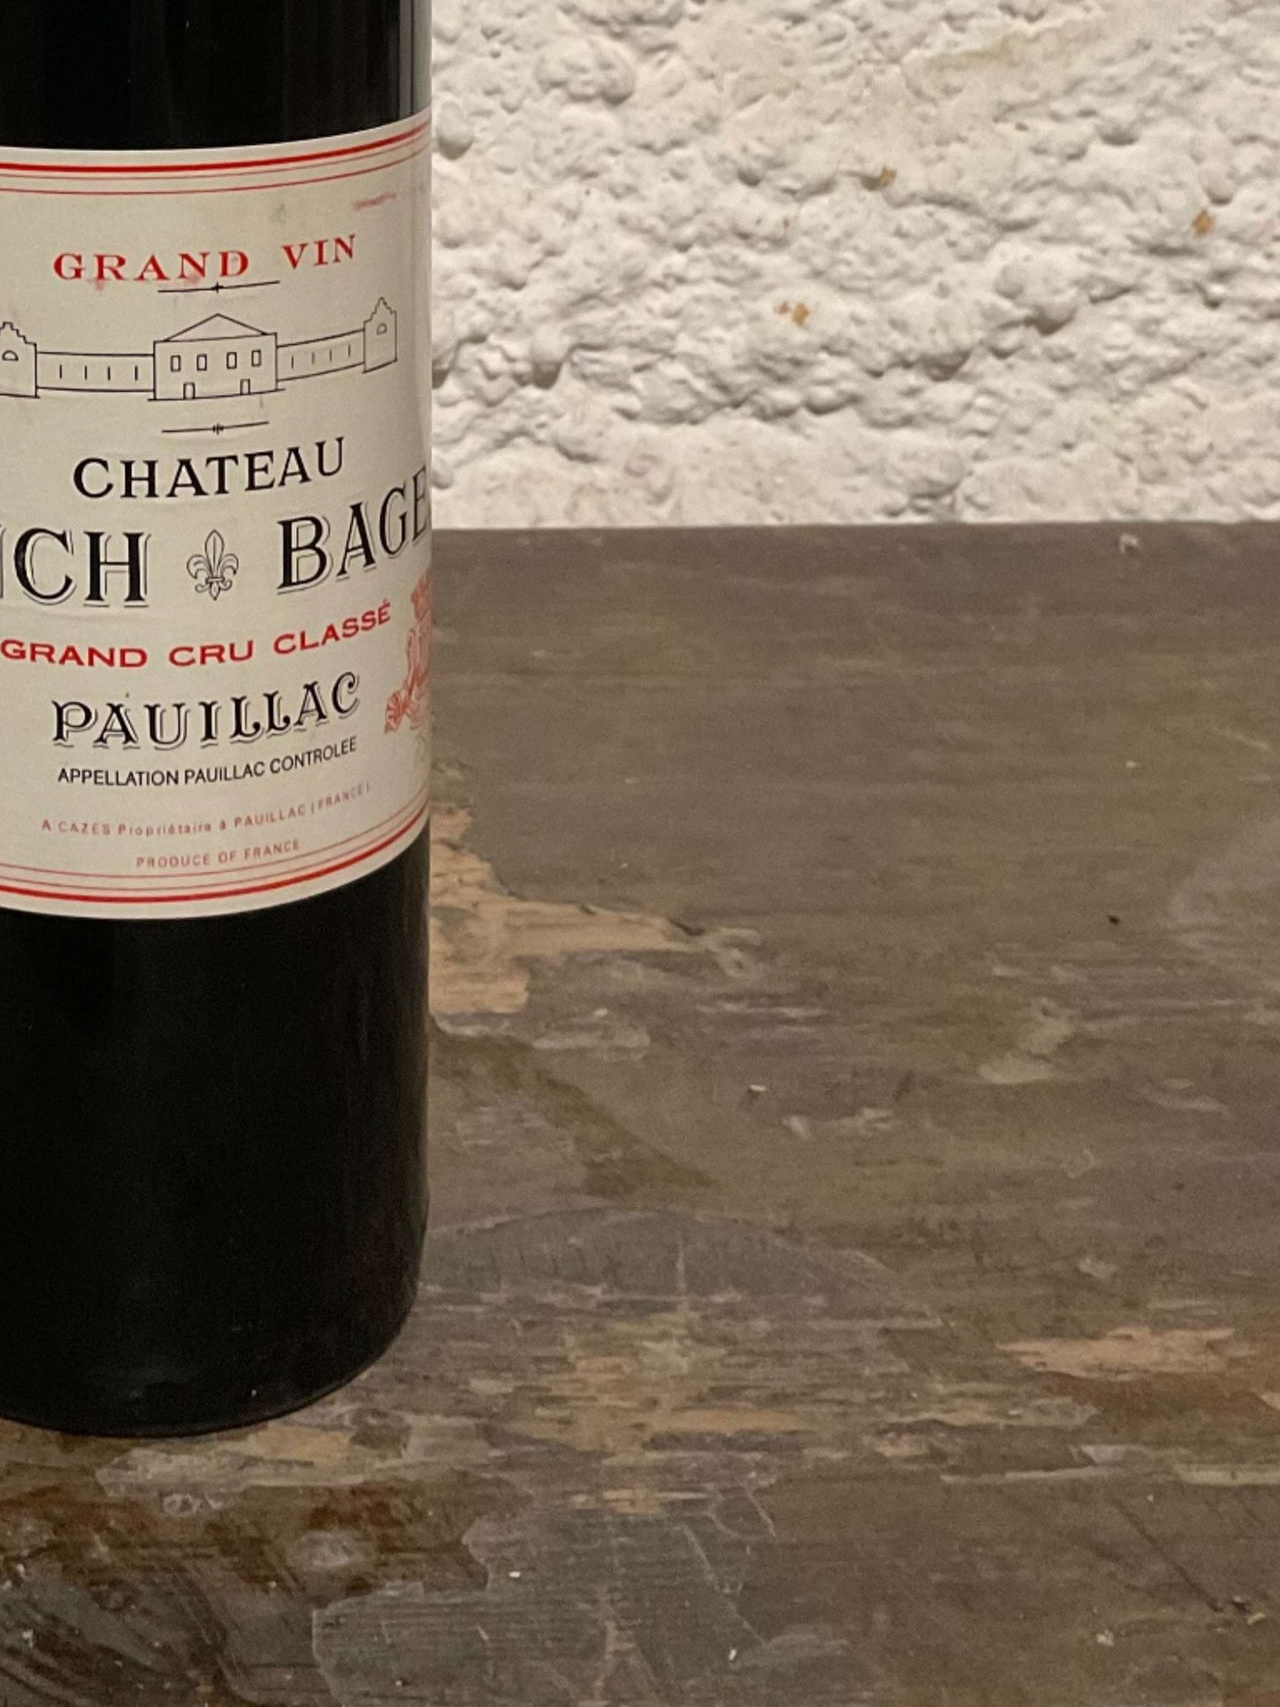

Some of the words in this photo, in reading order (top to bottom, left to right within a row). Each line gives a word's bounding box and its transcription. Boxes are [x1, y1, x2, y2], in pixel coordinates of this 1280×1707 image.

[54, 249, 251, 282] GRAND
[281, 235, 357, 271] VIN
[73, 437, 347, 500] CHATEAU
[0, 638, 149, 669] GRAND
[168, 639, 255, 668] CRU
[272, 598, 392, 657] CLASSÉ
[51, 670, 361, 752] PAUILLAC
[58, 765, 180, 787] APPELLATION
[183, 761, 266, 786] PAUILLAC
[269, 737, 358, 776] CONTROLEE
[58, 820, 111, 835] CAZES
[234, 803, 306, 829] PAUILLAC
[136, 855, 211, 869] PRODUCE
[218, 851, 237, 864] OF
[244, 838, 302, 861] FRANCE
